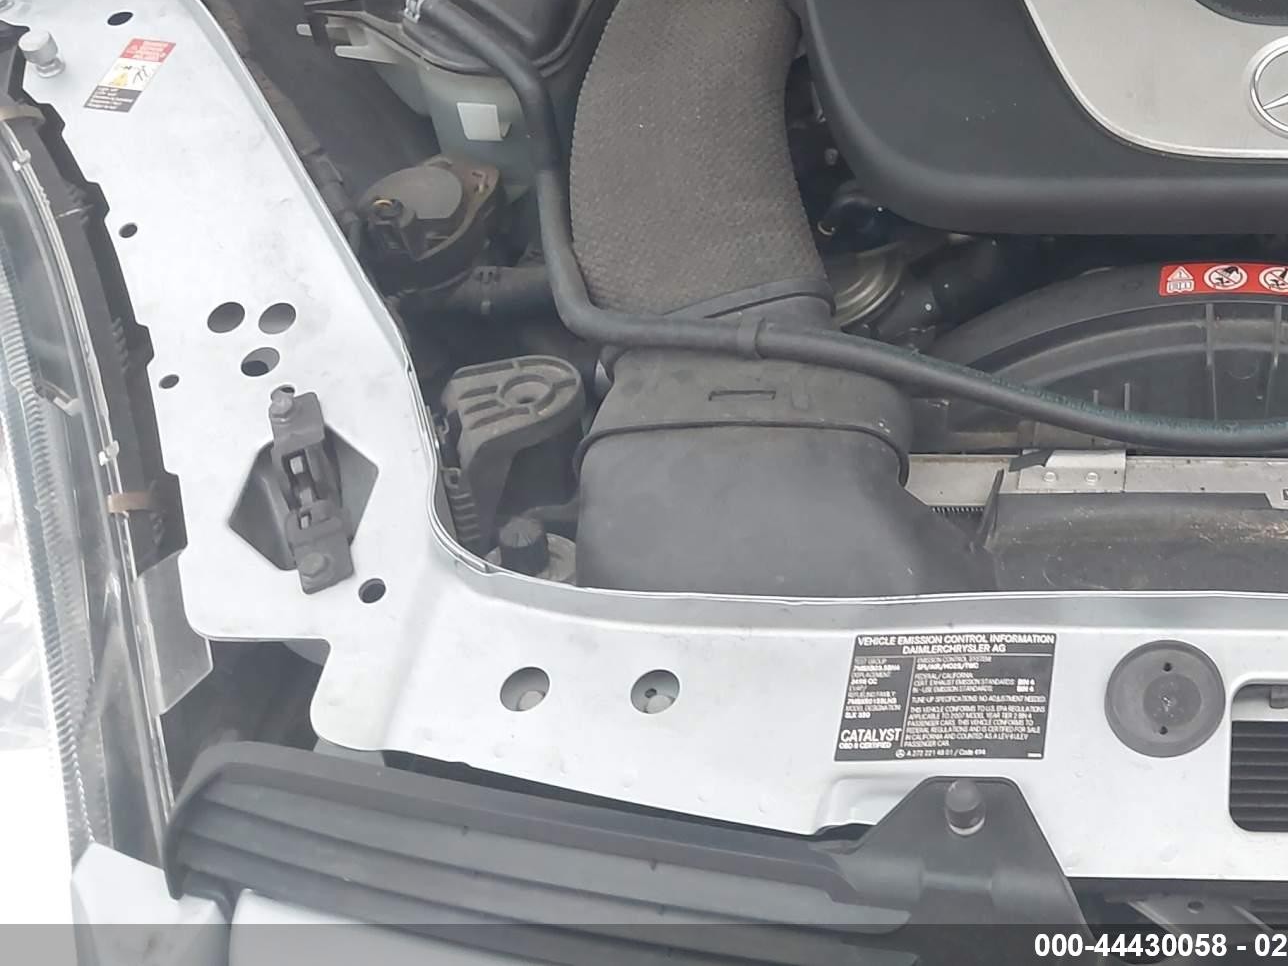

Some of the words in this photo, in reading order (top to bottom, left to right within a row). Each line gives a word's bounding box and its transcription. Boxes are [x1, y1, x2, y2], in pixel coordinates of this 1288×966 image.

[858, 636, 897, 646] VEHICLE
[898, 635, 942, 645] EMISSION
[944, 635, 988, 645] CONTROL
[990, 634, 1055, 644] INFORMATION
[902, 644, 991, 655] DAIMLERCHRYSLER
[992, 644, 1007, 653] AG
[841, 728, 902, 742] CATALYST
